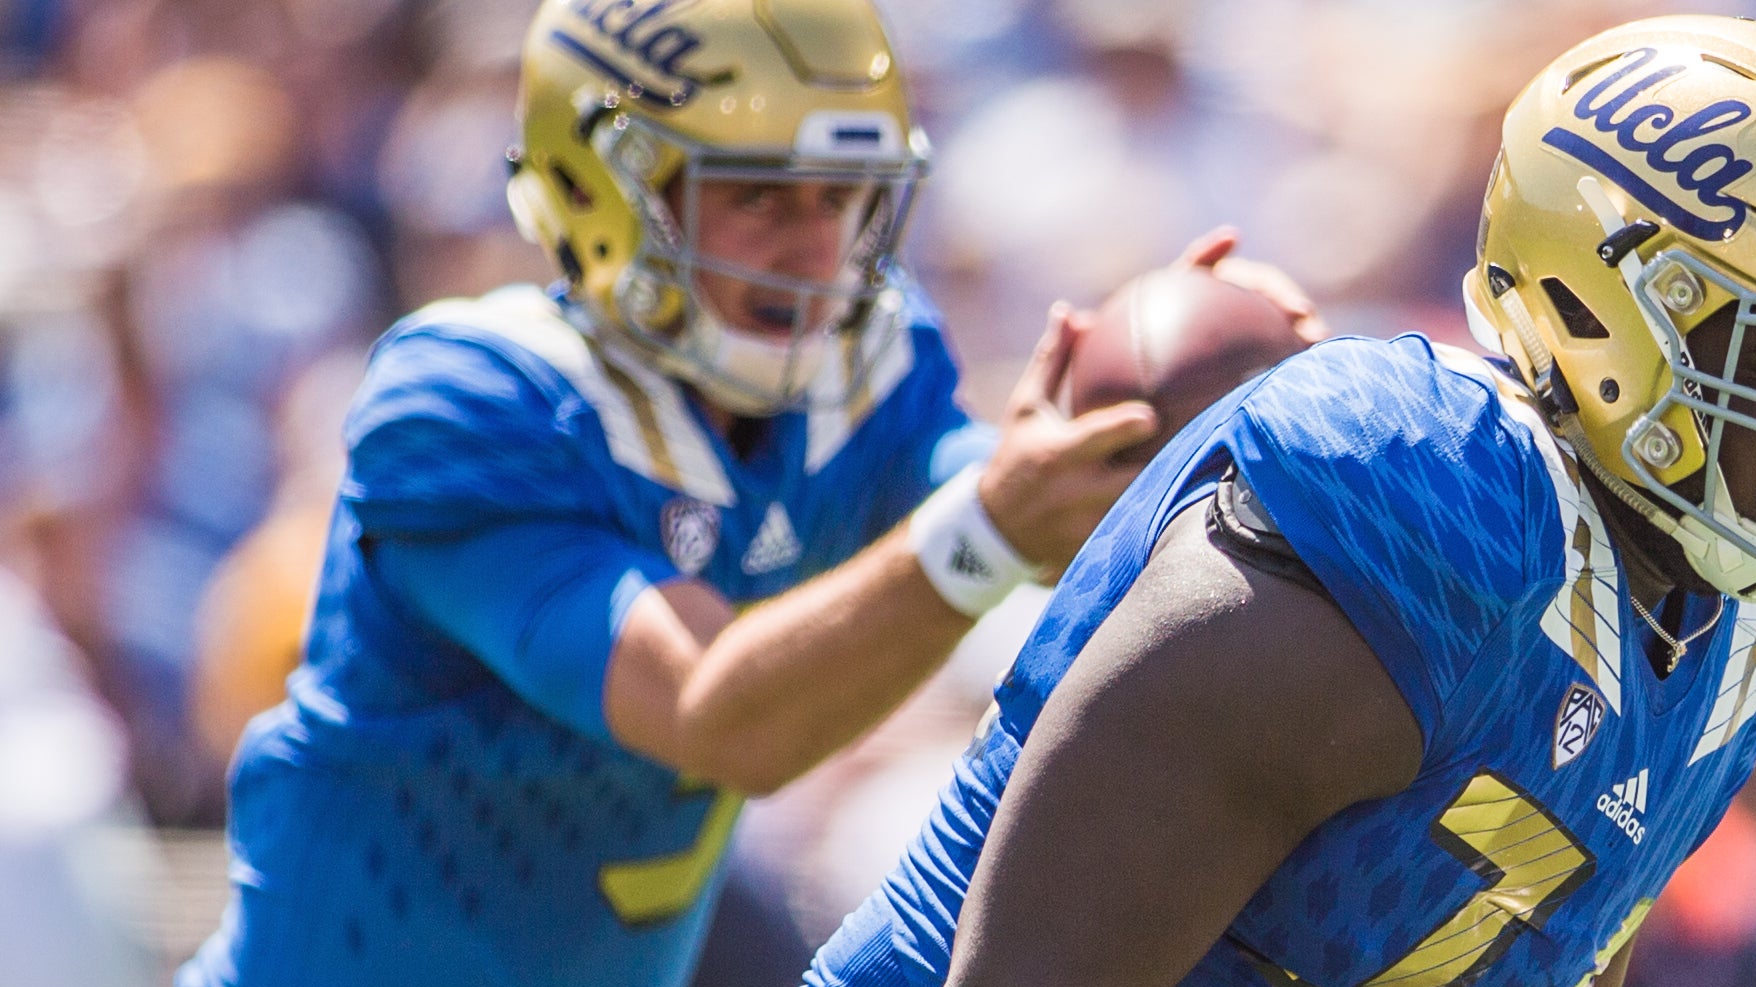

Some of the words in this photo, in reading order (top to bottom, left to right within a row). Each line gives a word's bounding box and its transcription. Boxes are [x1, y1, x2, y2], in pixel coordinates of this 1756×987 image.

[1573, 47, 1754, 208] Ucla
[1558, 720, 1585, 755] 12
[1560, 687, 1605, 746] PAC
[1596, 793, 1646, 846] adidas
